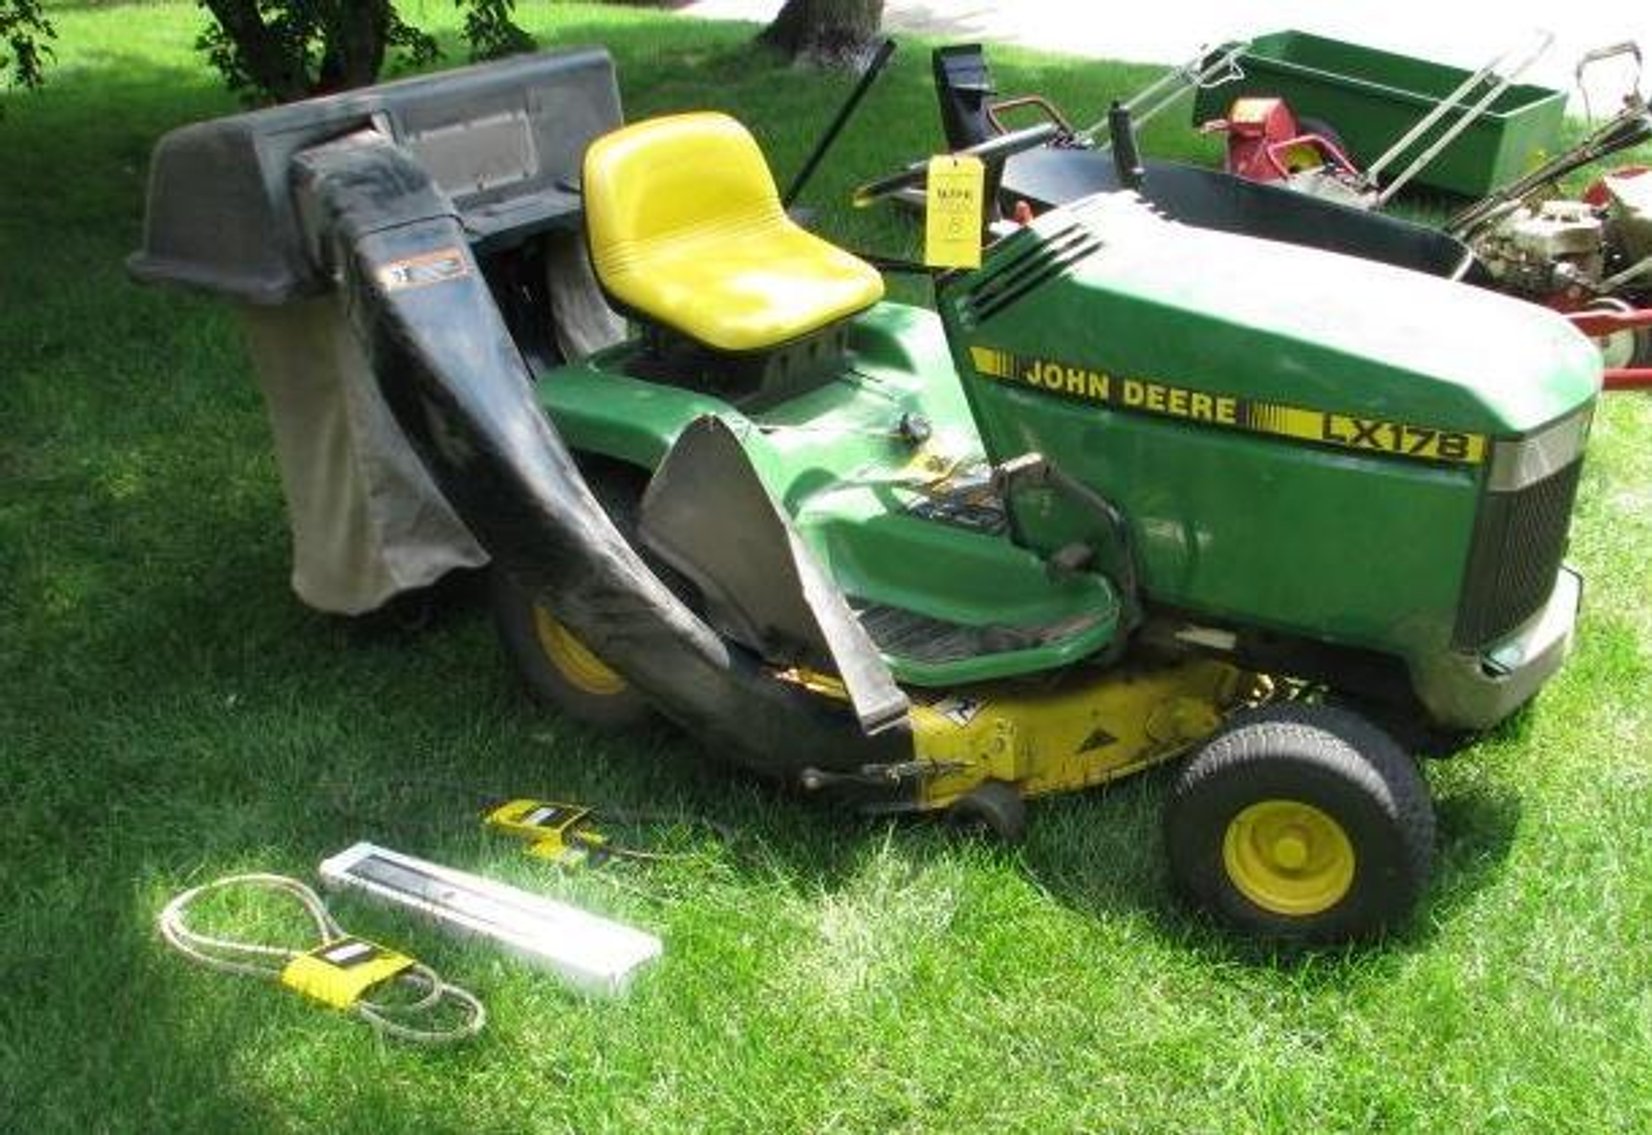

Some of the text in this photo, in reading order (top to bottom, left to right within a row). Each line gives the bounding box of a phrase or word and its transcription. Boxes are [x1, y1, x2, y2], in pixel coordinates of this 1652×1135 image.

[1026, 360, 1470, 459] JOHN DEERE LX178
